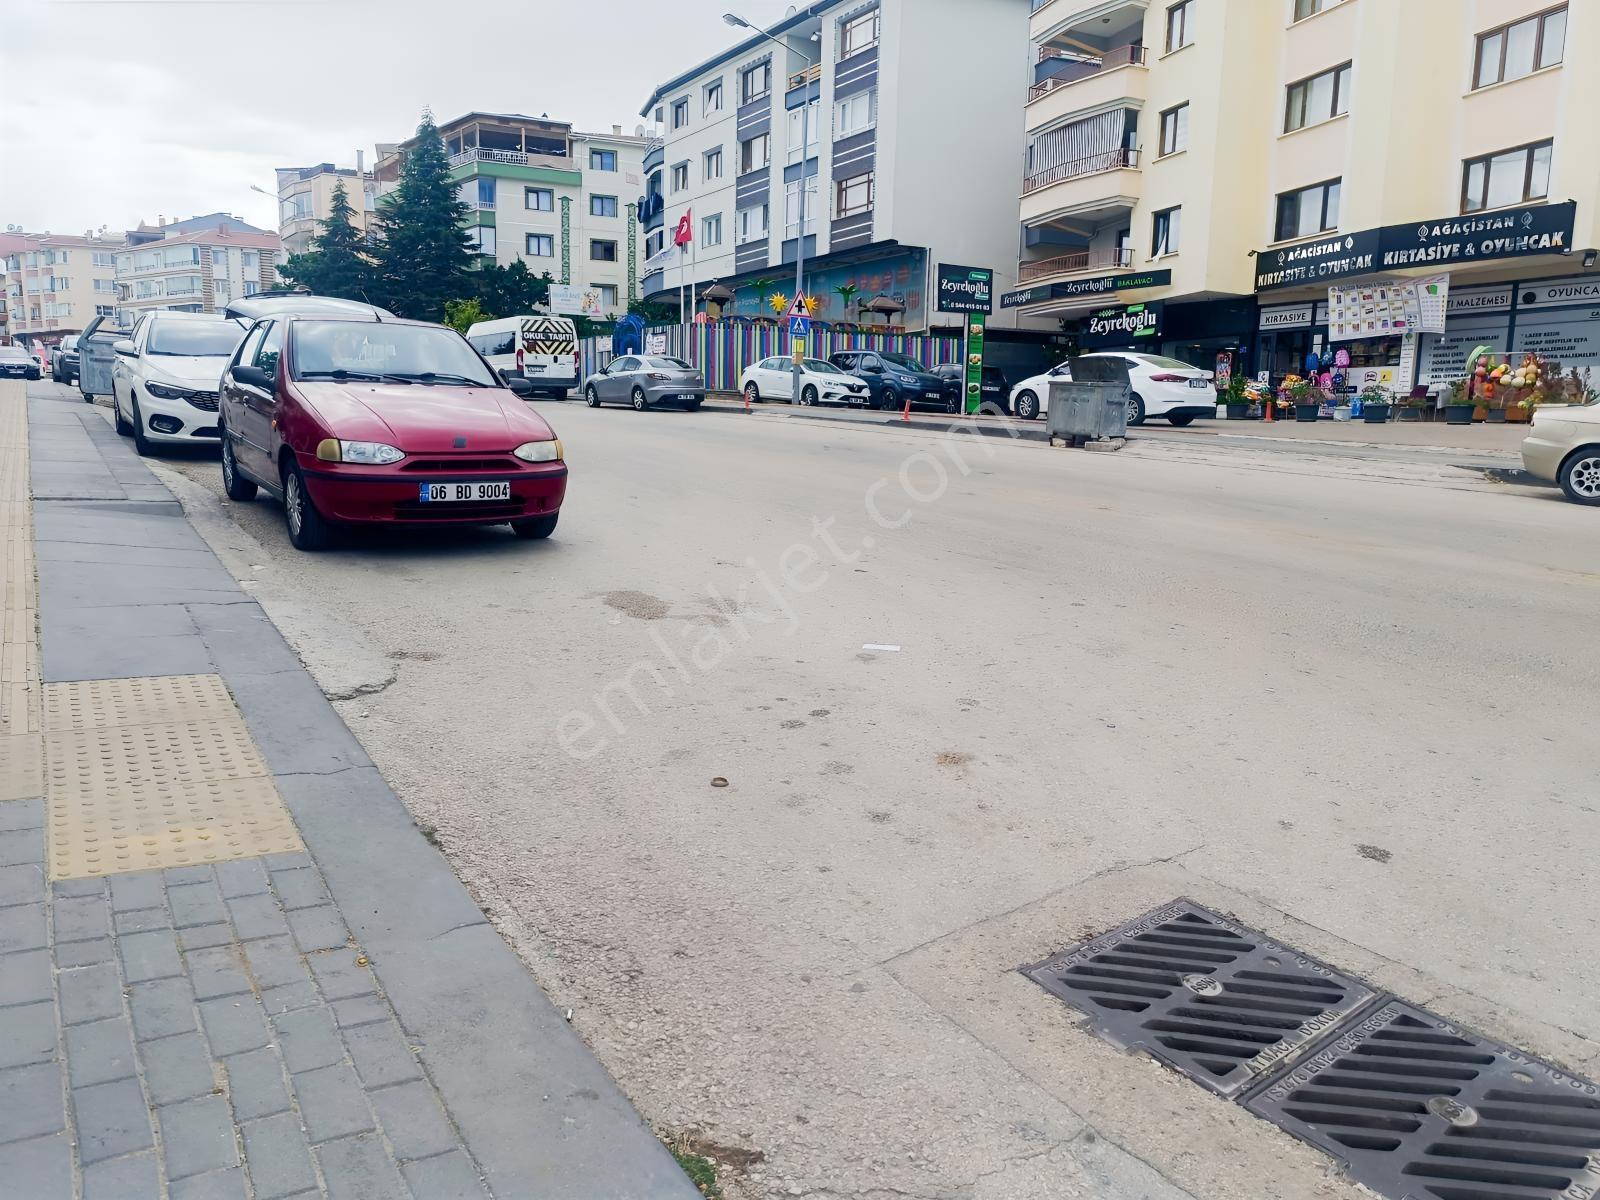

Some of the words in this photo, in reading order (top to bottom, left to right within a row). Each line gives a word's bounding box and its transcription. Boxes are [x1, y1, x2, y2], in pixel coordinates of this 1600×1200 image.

[1431, 216, 1514, 236] AĞAÇİSTAN
[1383, 242, 1460, 265] KIRTASİYE
[1464, 242, 1475, 256] &
[1480, 232, 1565, 254] OYUNCAK
[1318, 254, 1373, 276] OYUNCAK
[1548, 286, 1600, 304] OYUNCA
[1090, 309, 1157, 336] Zeyrekoğlu
[523, 331, 546, 340] OKUL
[431, 485, 447, 500] 06
[456, 484, 472, 500] BD
[478, 484, 508, 499] 9004
